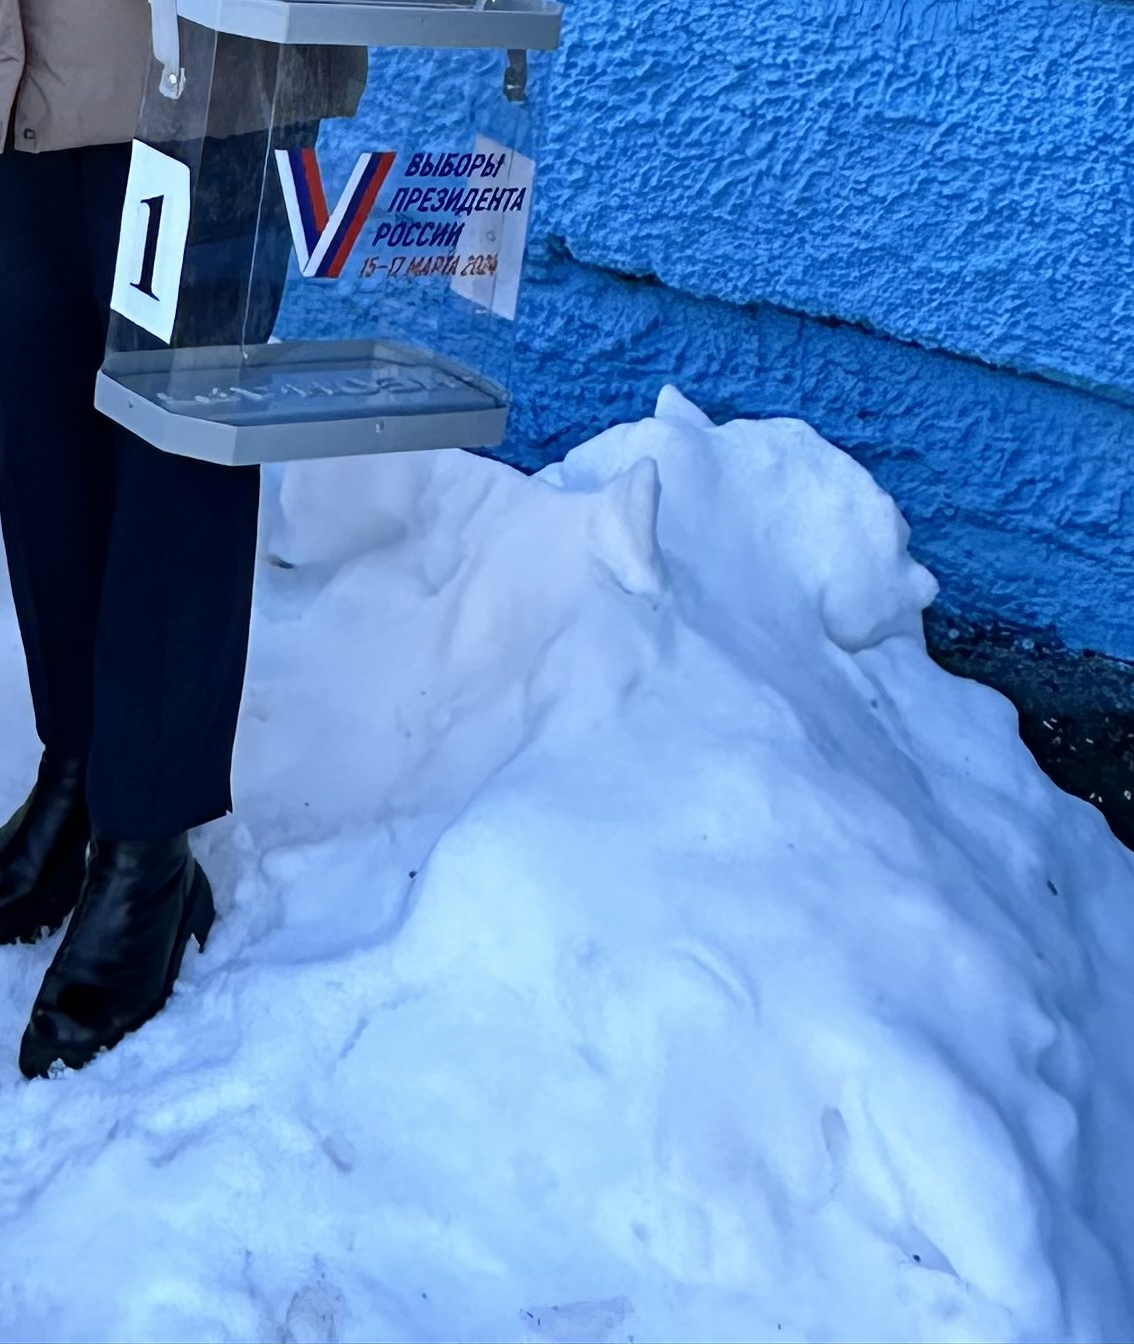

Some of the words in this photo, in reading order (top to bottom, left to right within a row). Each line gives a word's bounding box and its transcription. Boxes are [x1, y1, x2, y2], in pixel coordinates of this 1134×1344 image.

[404, 152, 506, 178] ВЫБОРЫ
[387, 186, 527, 217] ПРЕЗИДЕНТА
[130, 193, 165, 301] 1
[371, 221, 466, 247] РОССИИ
[404, 254, 461, 277] МАРТА
